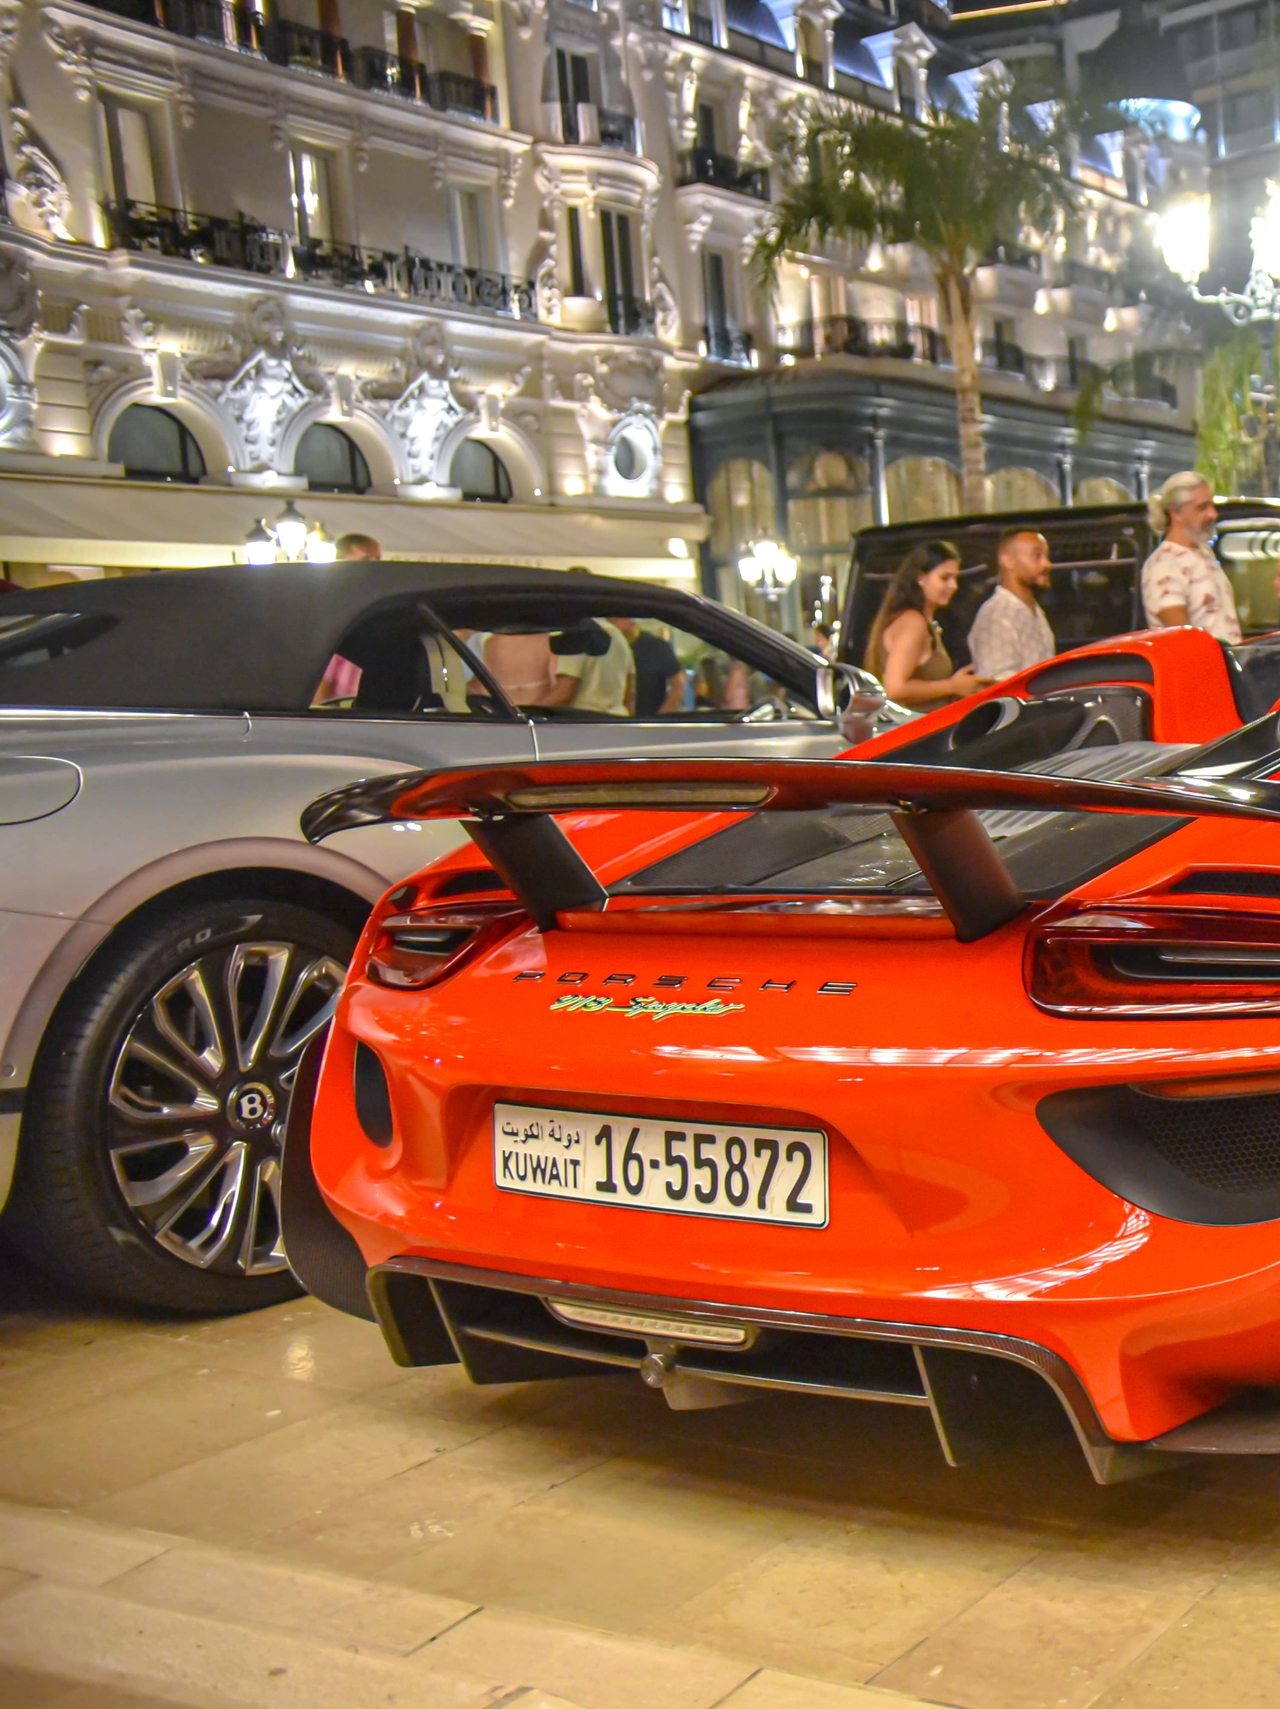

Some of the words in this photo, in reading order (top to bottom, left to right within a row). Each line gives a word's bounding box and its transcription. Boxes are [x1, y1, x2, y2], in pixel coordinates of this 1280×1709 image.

[513, 970, 857, 995] PORSCHE
[550, 994, 613, 1012] 918
[608, 996, 745, 1021] Spyder
[239, 1093, 264, 1119] B
[501, 1119, 544, 1144] الكويت
[548, 1119, 581, 1149] دولة
[501, 1149, 581, 1190] KUWAIT
[594, 1123, 815, 1214] 16-55872
